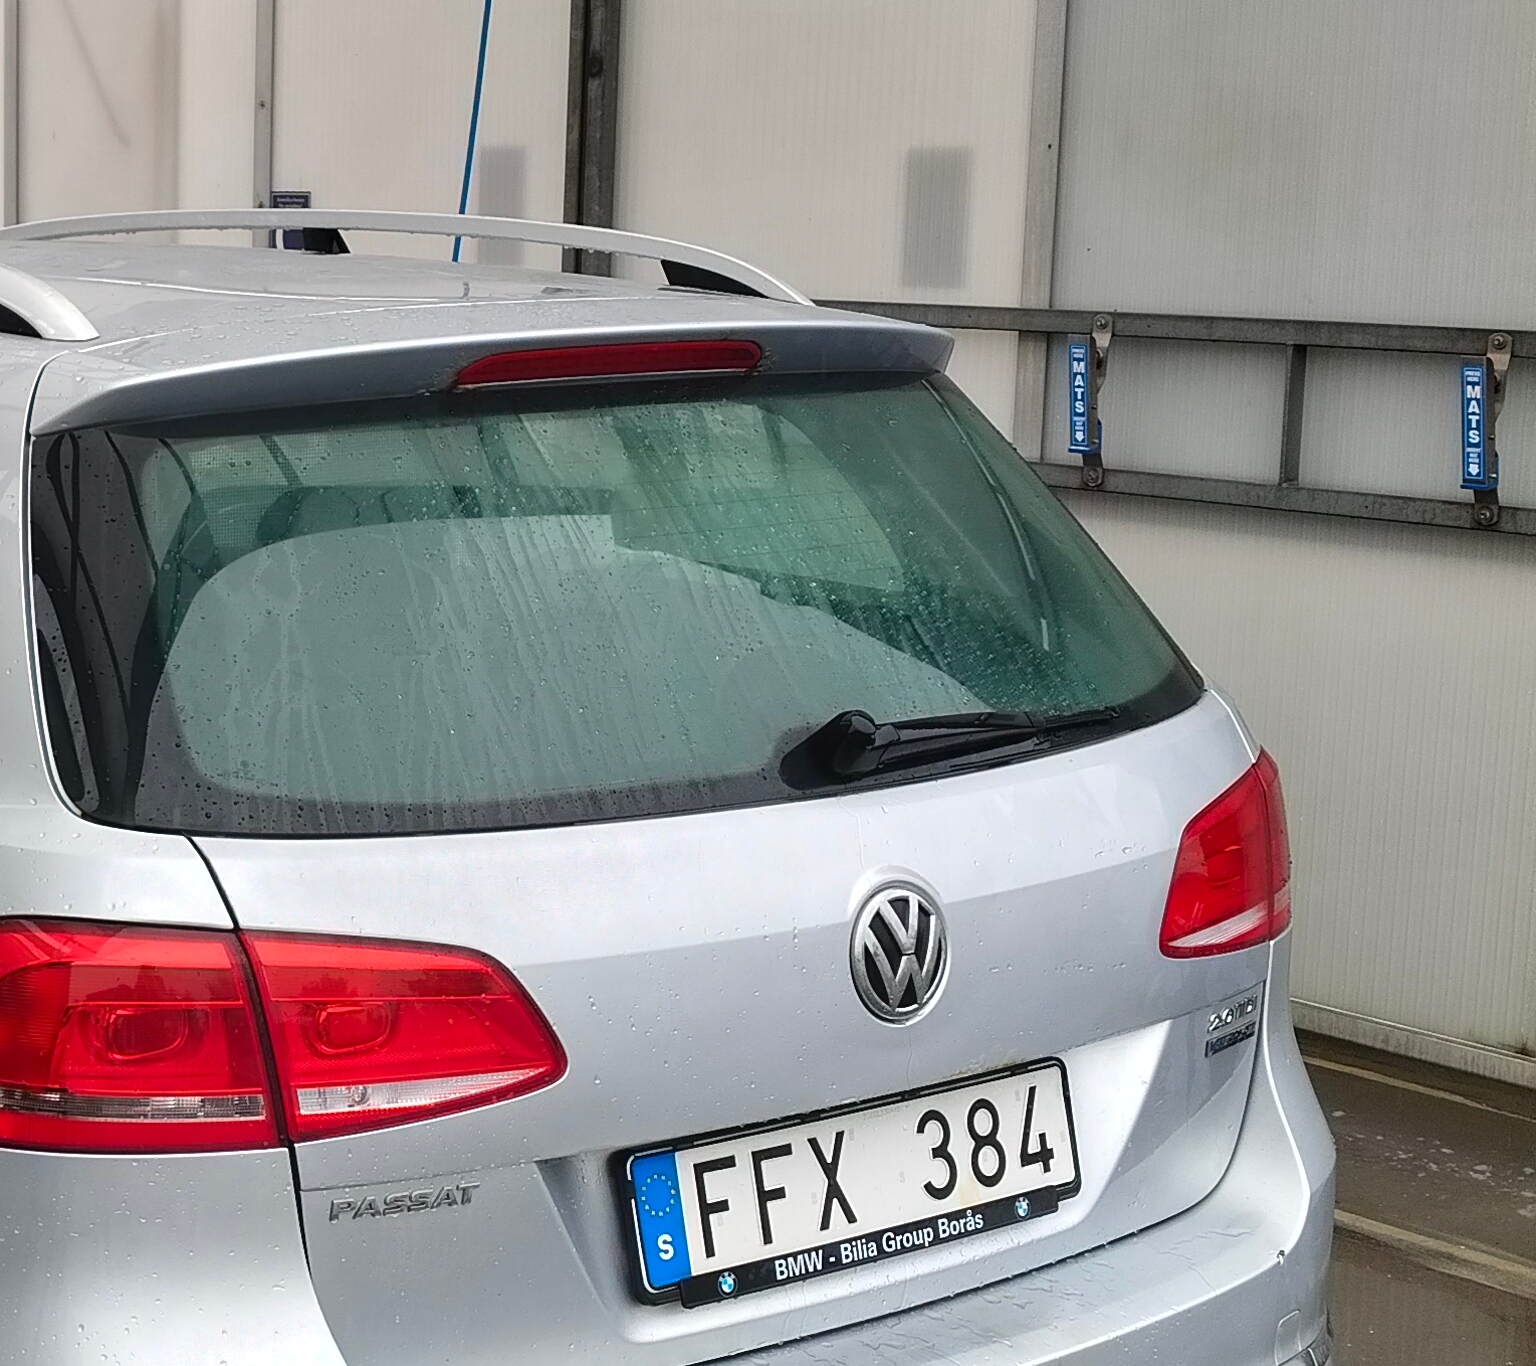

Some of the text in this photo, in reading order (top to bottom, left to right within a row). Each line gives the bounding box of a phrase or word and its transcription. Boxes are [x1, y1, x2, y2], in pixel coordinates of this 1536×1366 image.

[1073, 360, 1085, 413] MATS
[1466, 385, 1481, 443] MATS
[858, 889, 941, 1014] VW
[693, 1085, 1055, 1259] FFX 384
[329, 1182, 481, 1222] PASSAT
[657, 1233, 675, 1260] S
[774, 1249, 824, 1281] BMW
[840, 1239, 878, 1264] Bilia
[882, 1226, 933, 1253] Group
[937, 1210, 984, 1239] Borås
